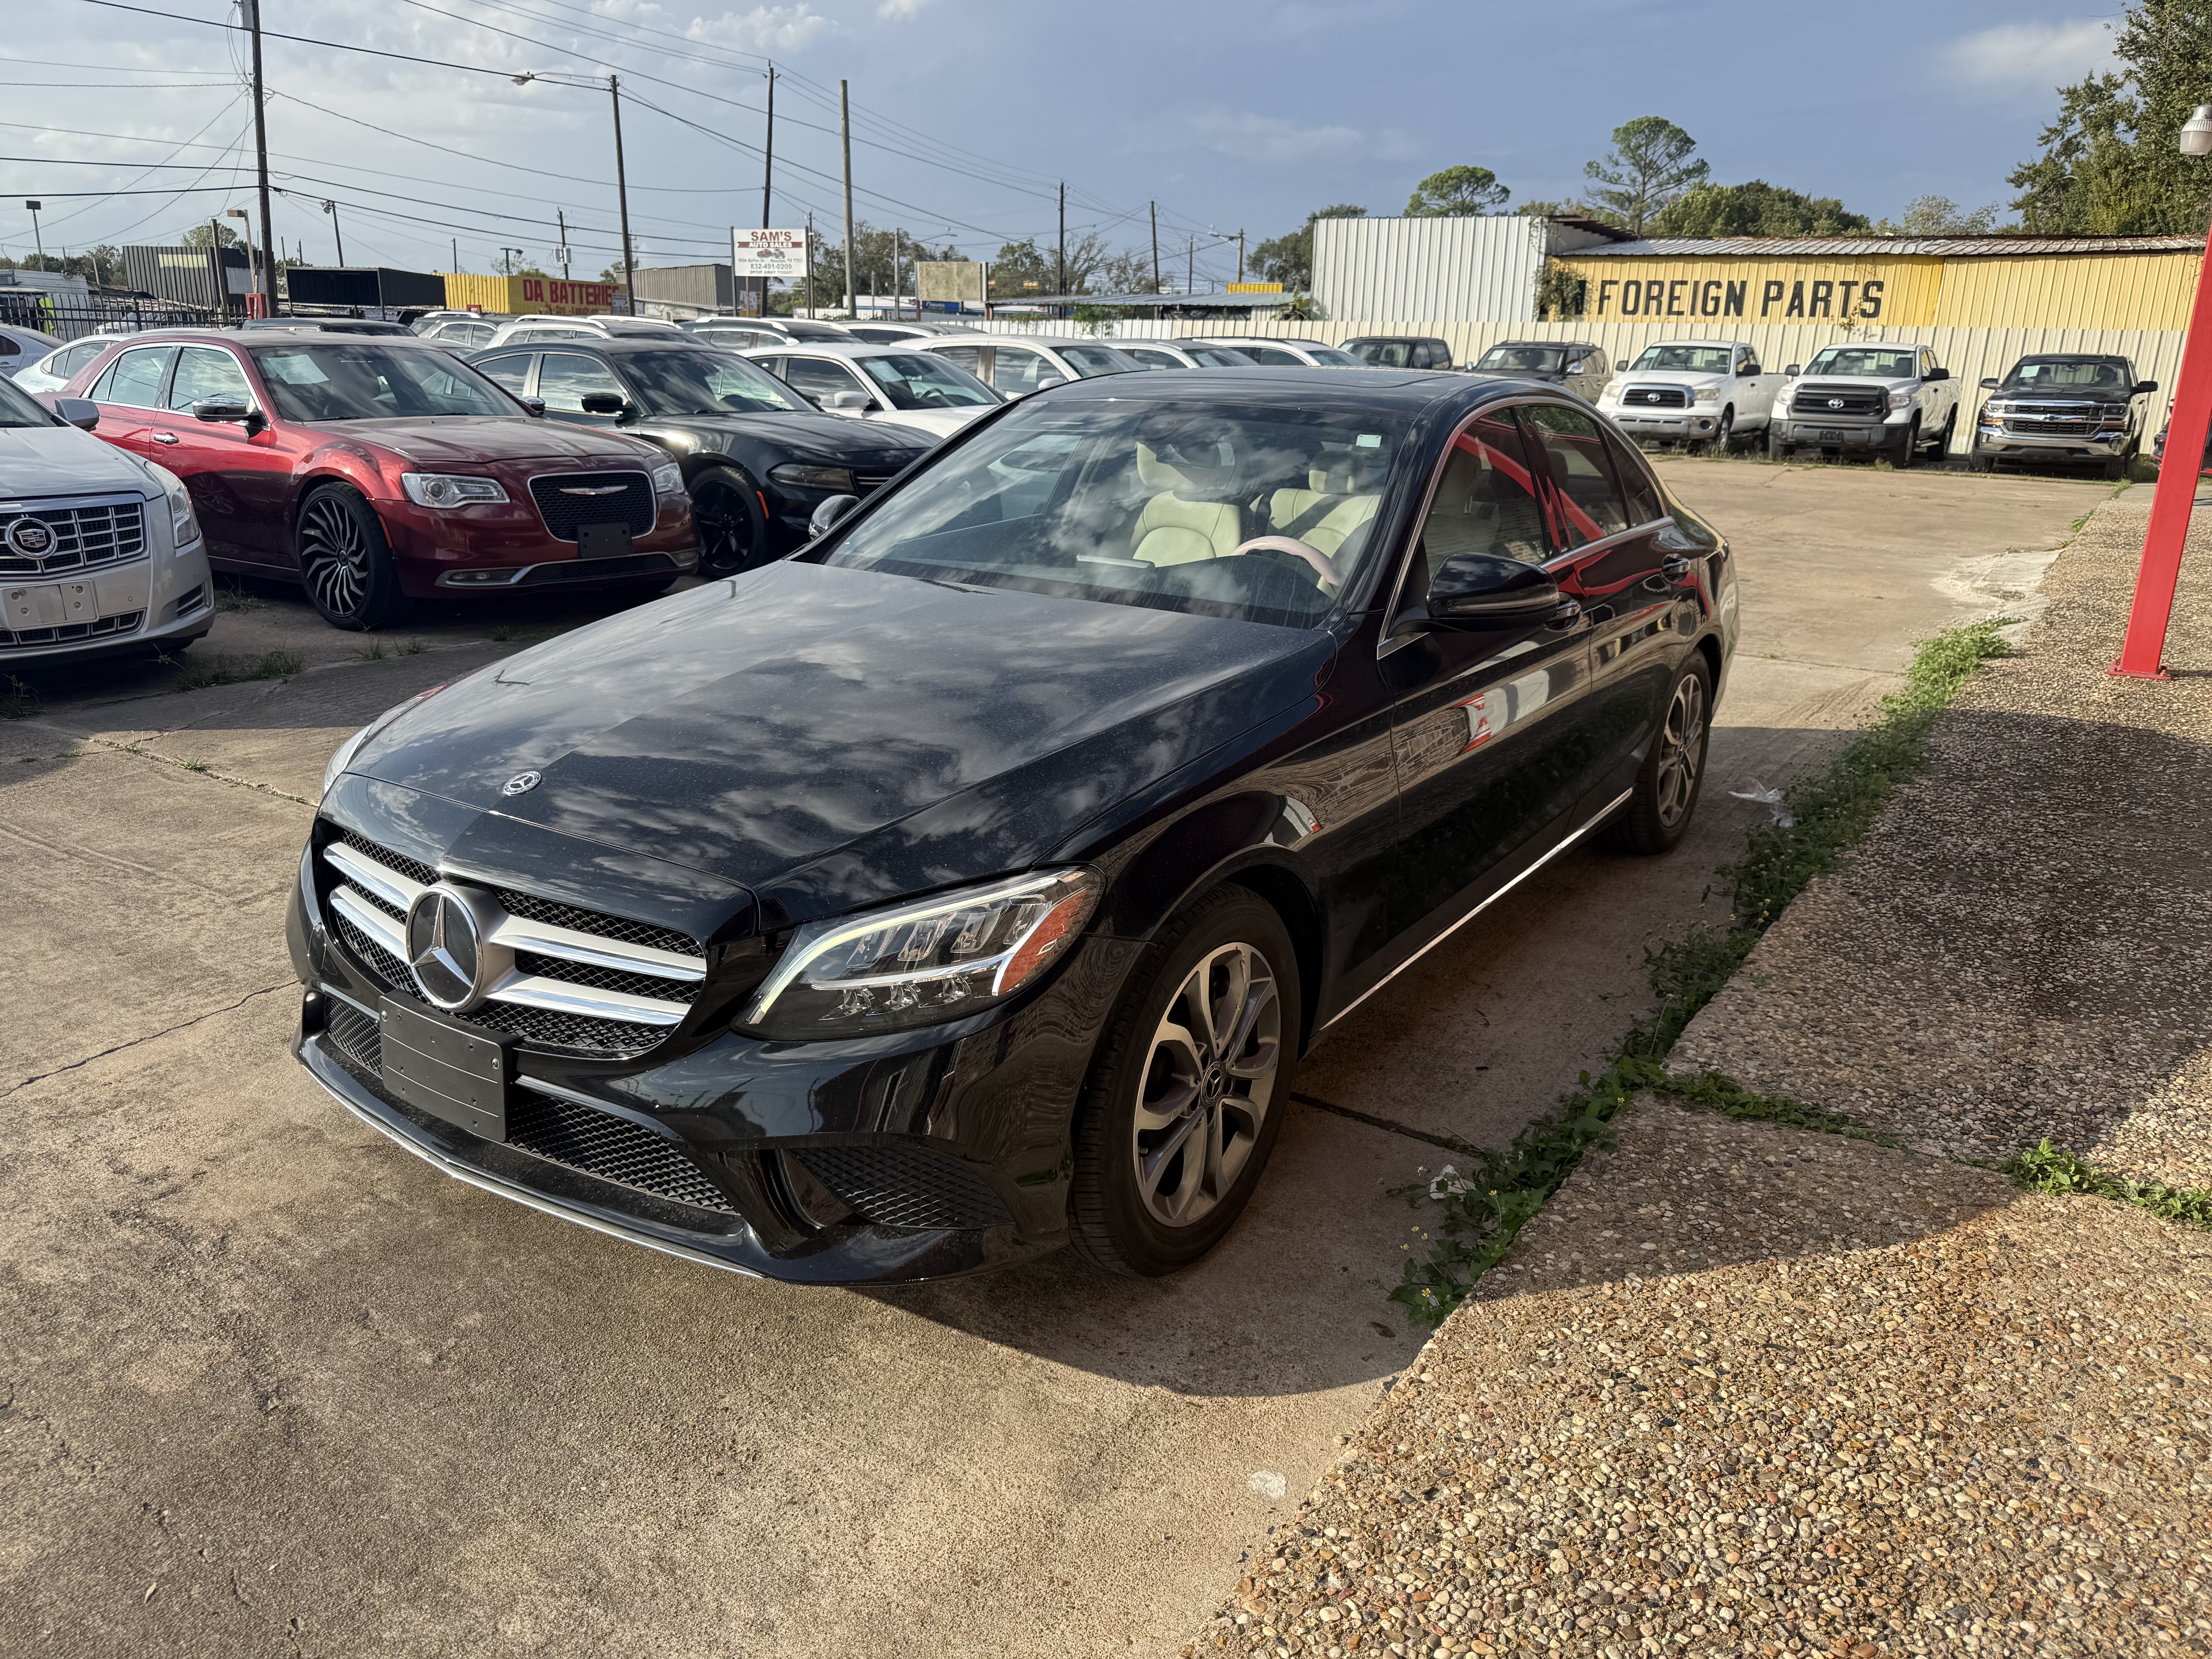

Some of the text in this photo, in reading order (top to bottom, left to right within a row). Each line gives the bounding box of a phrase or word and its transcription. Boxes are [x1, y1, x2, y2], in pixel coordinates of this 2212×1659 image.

[751, 232, 791, 241] SAM'S
[523, 279, 544, 302] DA
[1597, 280, 1747, 317] FOREIGN
[1761, 280, 1884, 318] PARTS
